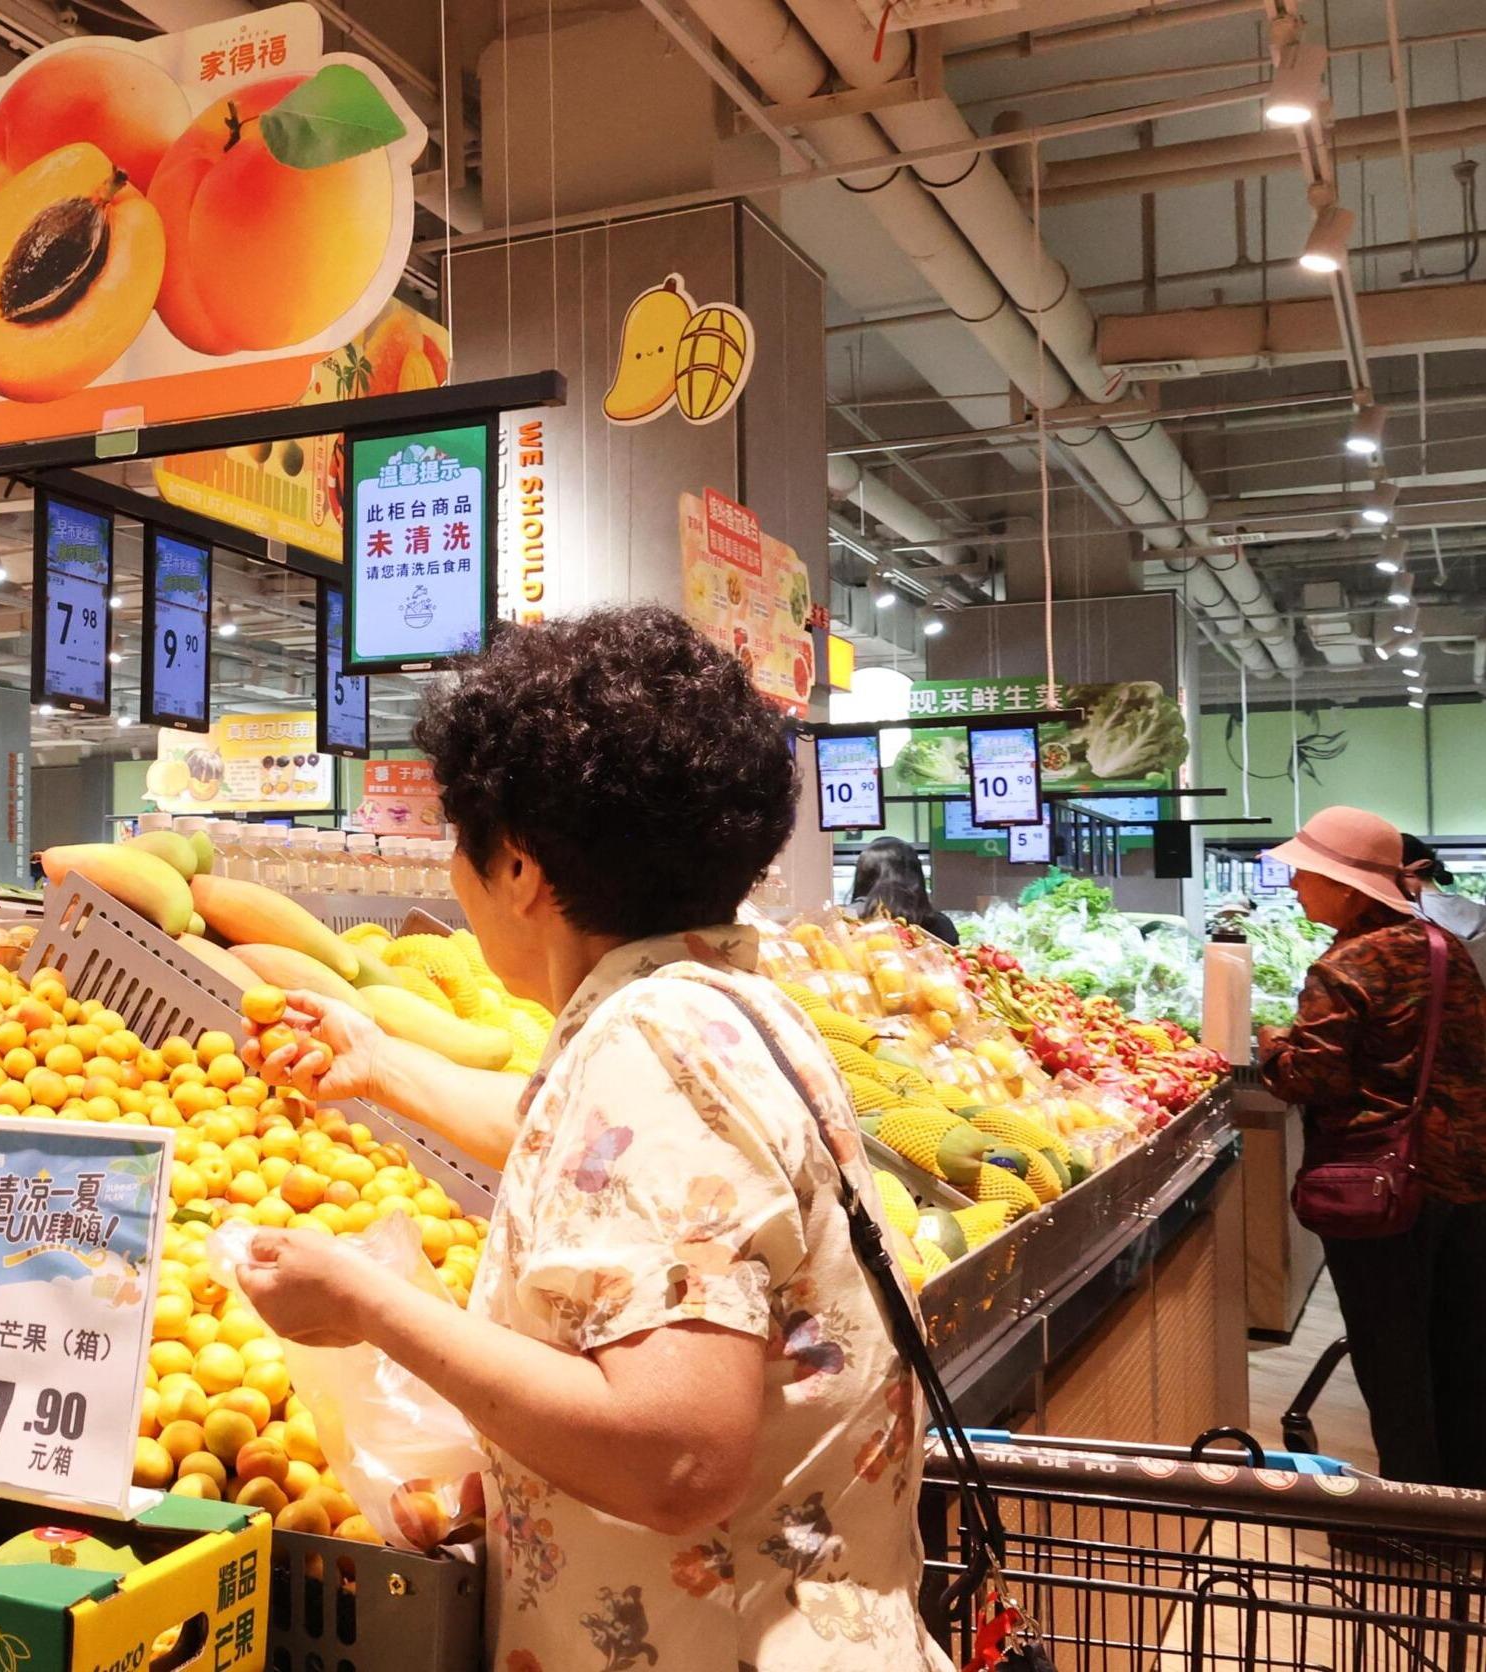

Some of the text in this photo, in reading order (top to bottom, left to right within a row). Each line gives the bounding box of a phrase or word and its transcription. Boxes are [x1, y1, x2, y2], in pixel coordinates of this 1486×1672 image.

[200, 34, 288, 82] 家得福
[519, 420, 544, 468] WE
[378, 458, 462, 488] 温馨提示
[366, 495, 472, 523] 此柜台商品
[366, 521, 472, 558] 未清洗
[519, 476, 545, 603] SHOULD
[366, 558, 472, 581] 请您清洗后食用
[82, 608, 98, 629] 98
[185, 635, 198, 653] 90
[908, 684, 1064, 714] 现采鲜生菜
[825, 782, 875, 804] 10 90
[979, 775, 1033, 798] 10 90
[1018, 833, 1028, 847] 5
[28, 1442, 72, 1477] 元/箱
[217, 1549, 258, 1615] 精品
[214, 1607, 255, 1672] 芒果
